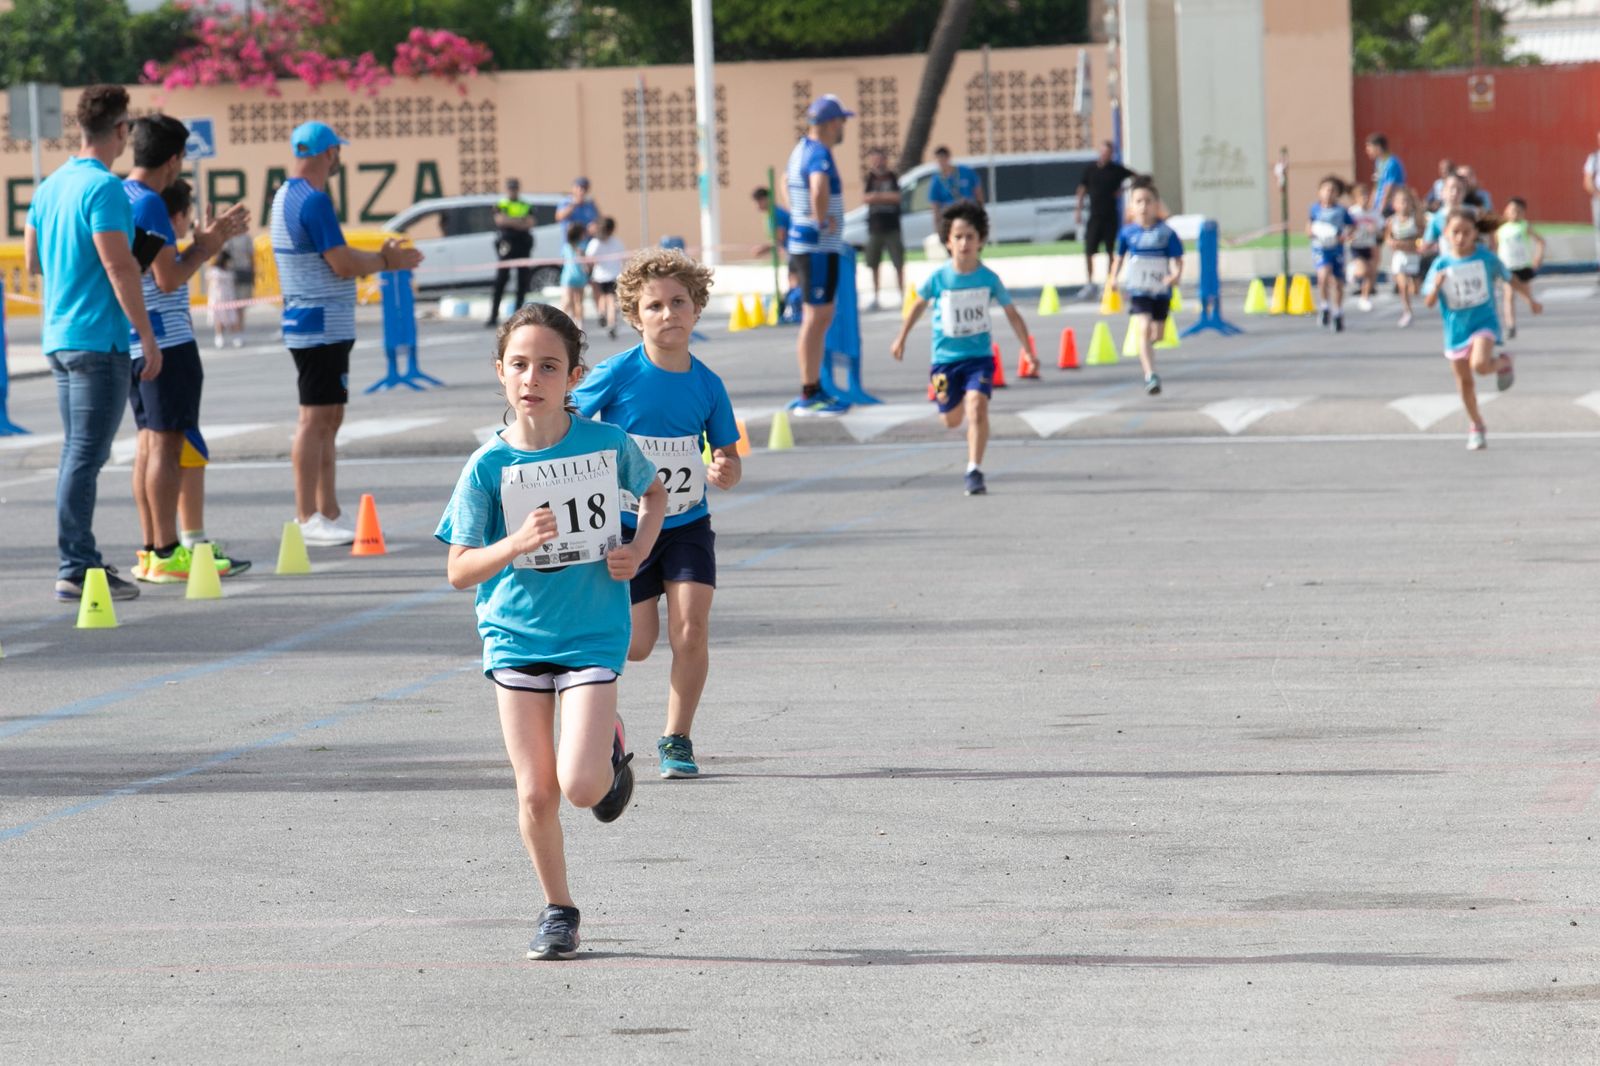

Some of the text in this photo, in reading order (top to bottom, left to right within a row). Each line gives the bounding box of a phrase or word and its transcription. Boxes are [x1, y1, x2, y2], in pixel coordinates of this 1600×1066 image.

[7, 160, 445, 238] ERANZA
[955, 303, 984, 323] 108
[642, 438, 697, 452] MILLA
[536, 455, 608, 481] MILLA
[521, 477, 560, 490] POPULAR
[563, 476, 574, 485] DE
[536, 492, 606, 534] 18
